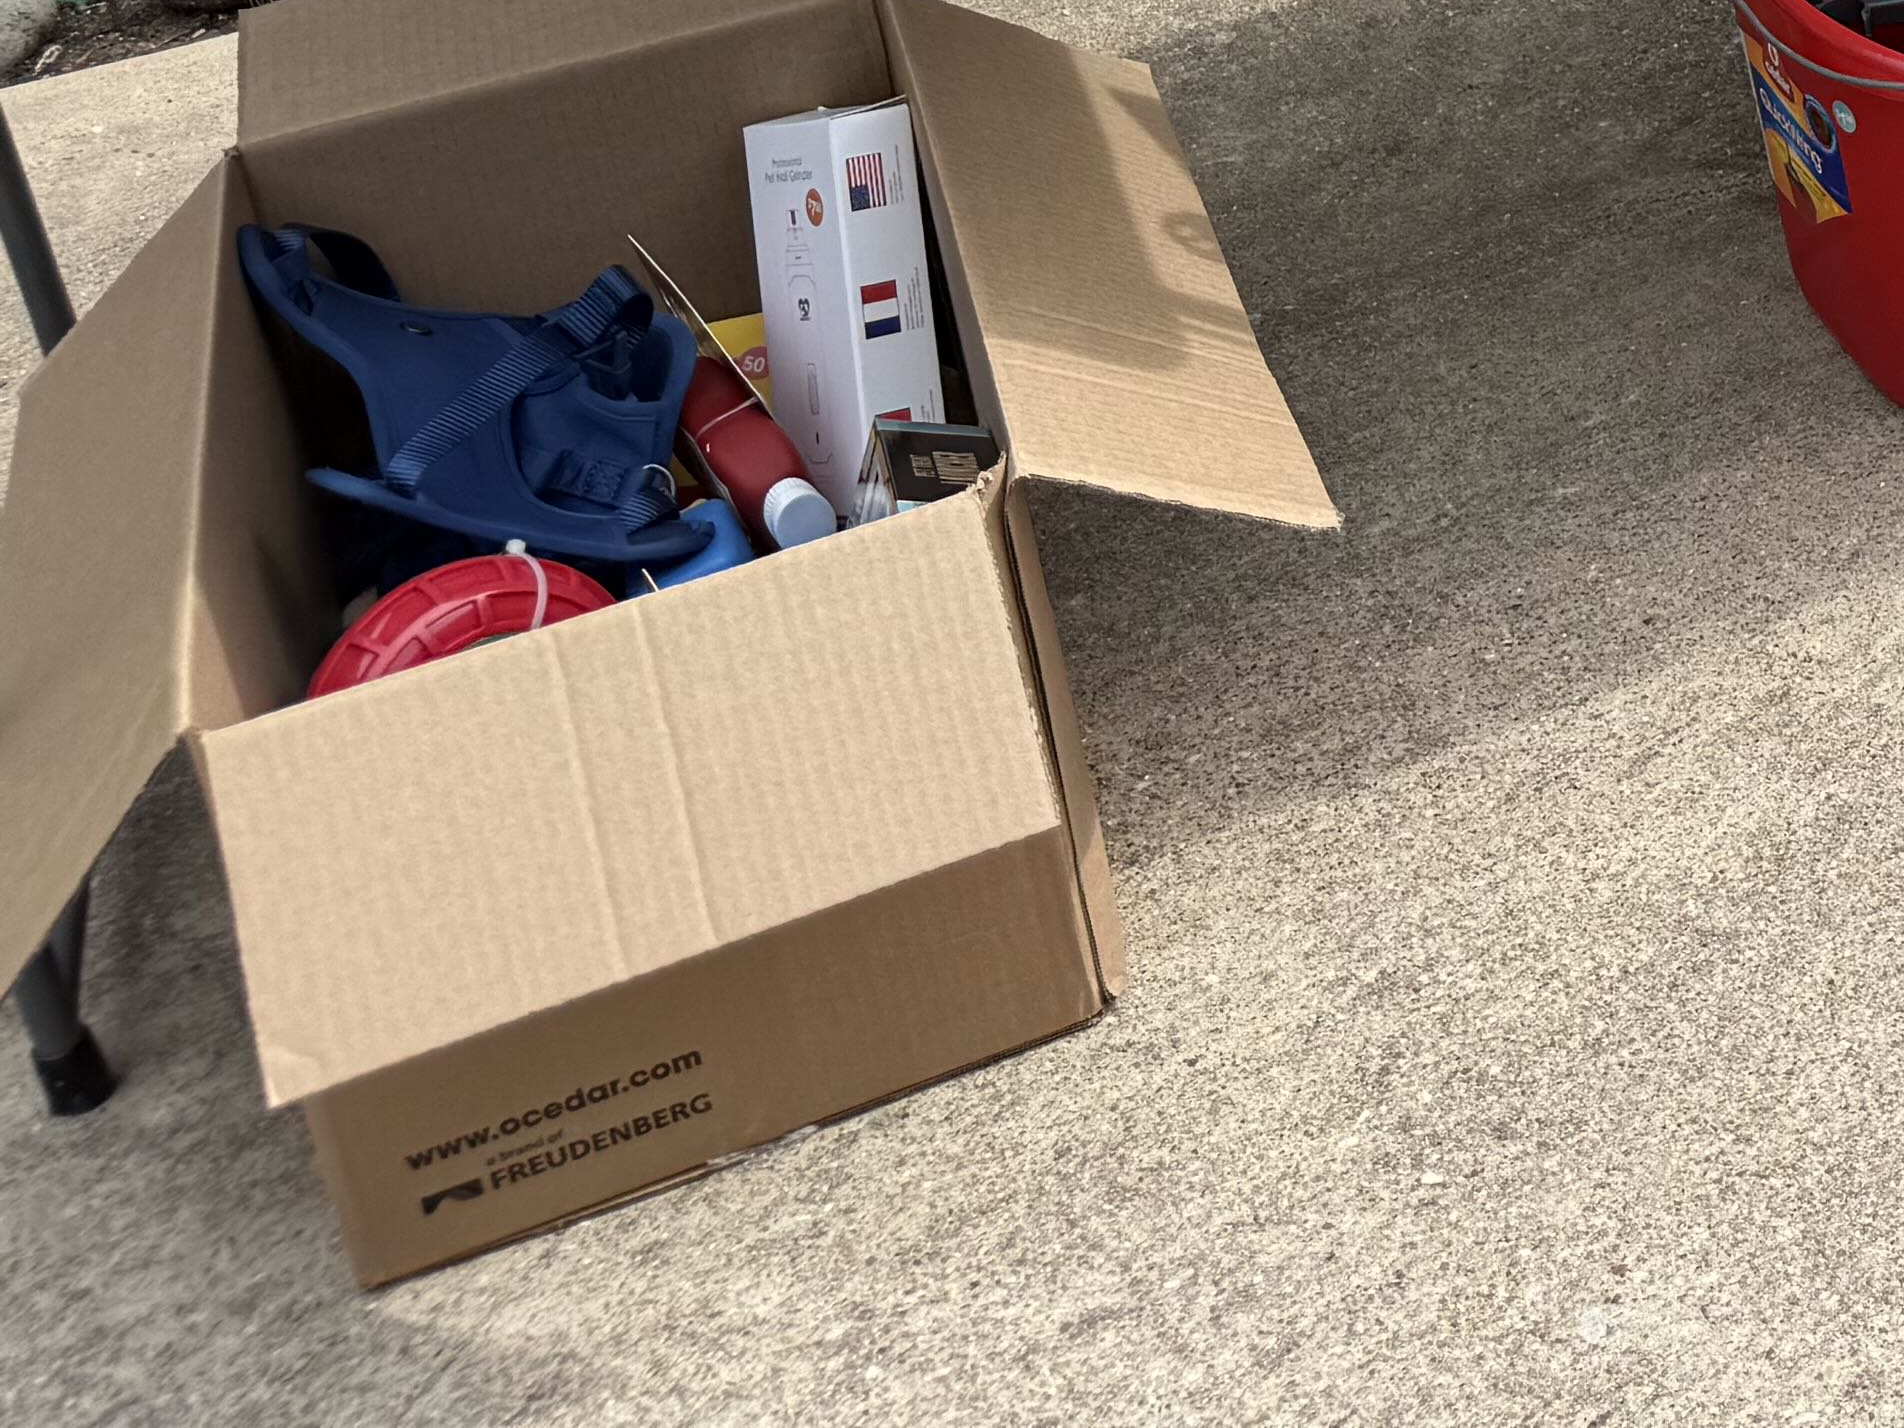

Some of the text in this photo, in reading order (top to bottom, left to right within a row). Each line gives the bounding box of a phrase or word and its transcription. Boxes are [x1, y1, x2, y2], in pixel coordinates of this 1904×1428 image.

[404, 1049, 703, 1171] www.ocedar.com
[490, 1093, 714, 1191] FREUDENBERG
[499, 1137, 544, 1162] brand
